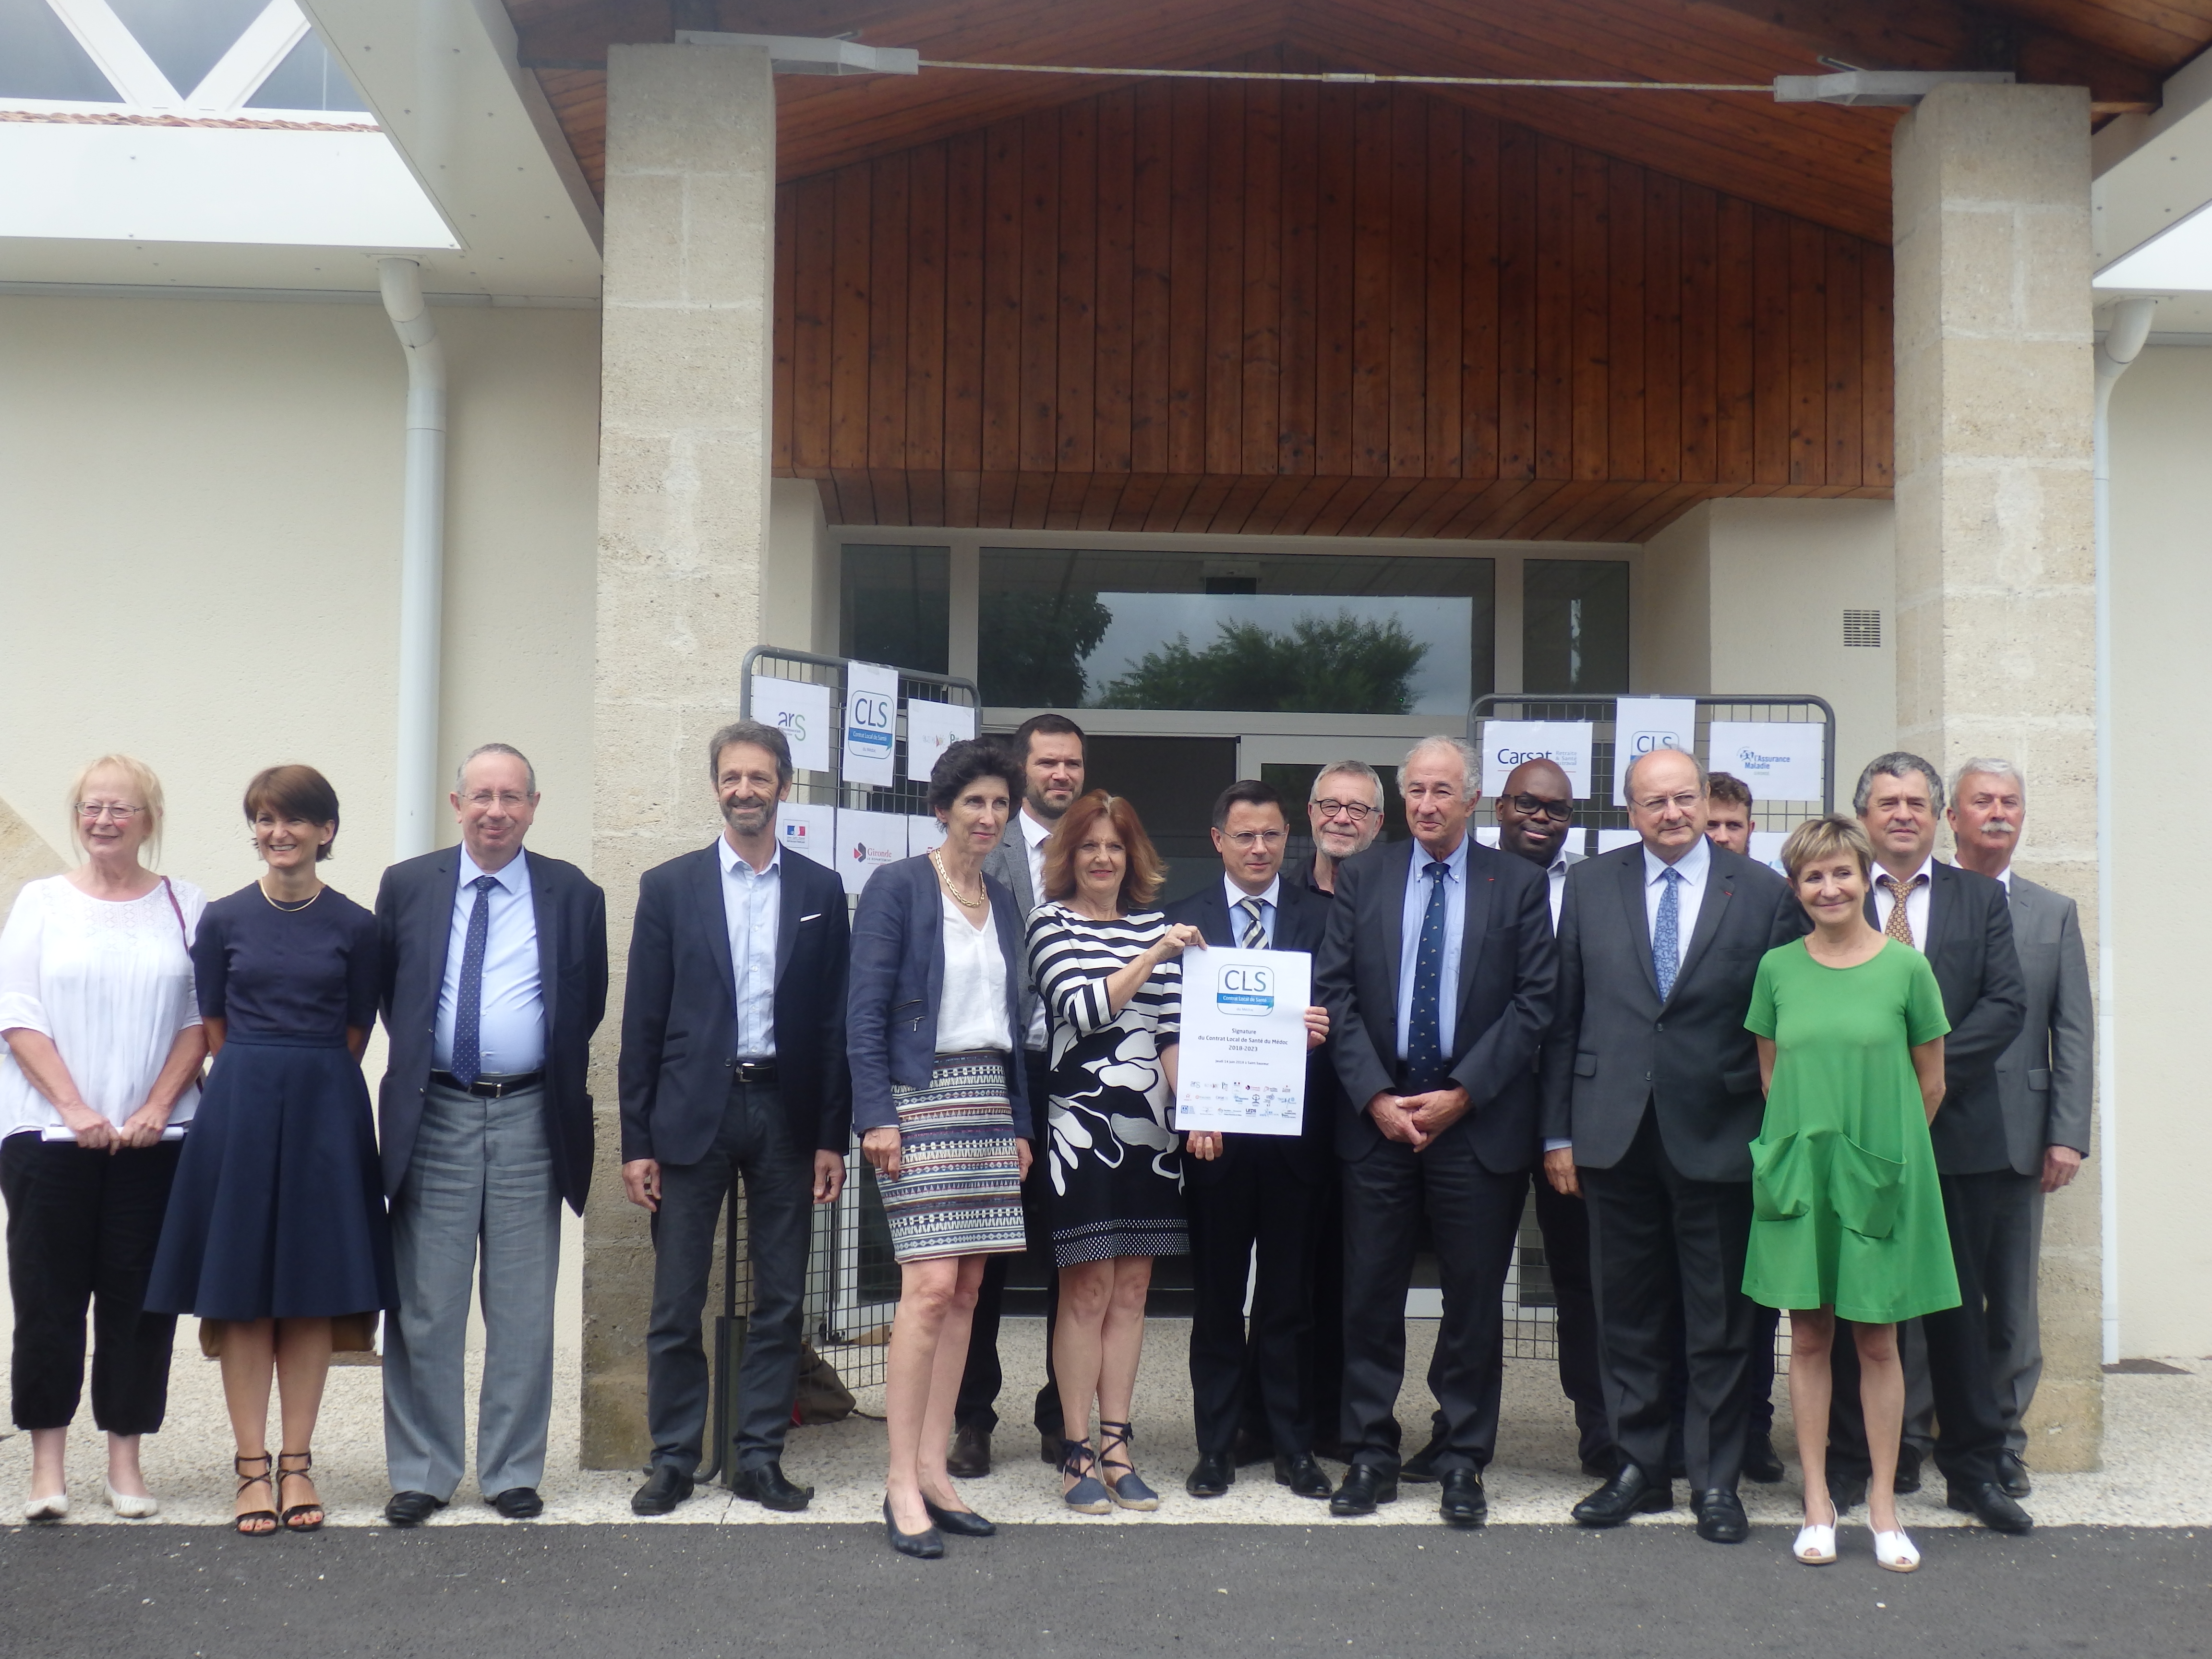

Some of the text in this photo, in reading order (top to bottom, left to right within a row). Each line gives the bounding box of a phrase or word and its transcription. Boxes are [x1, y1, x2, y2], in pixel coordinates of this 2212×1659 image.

[855, 698, 888, 728] CLS
[867, 848, 892, 857] Gironde
[1225, 970, 1266, 992] CLS
